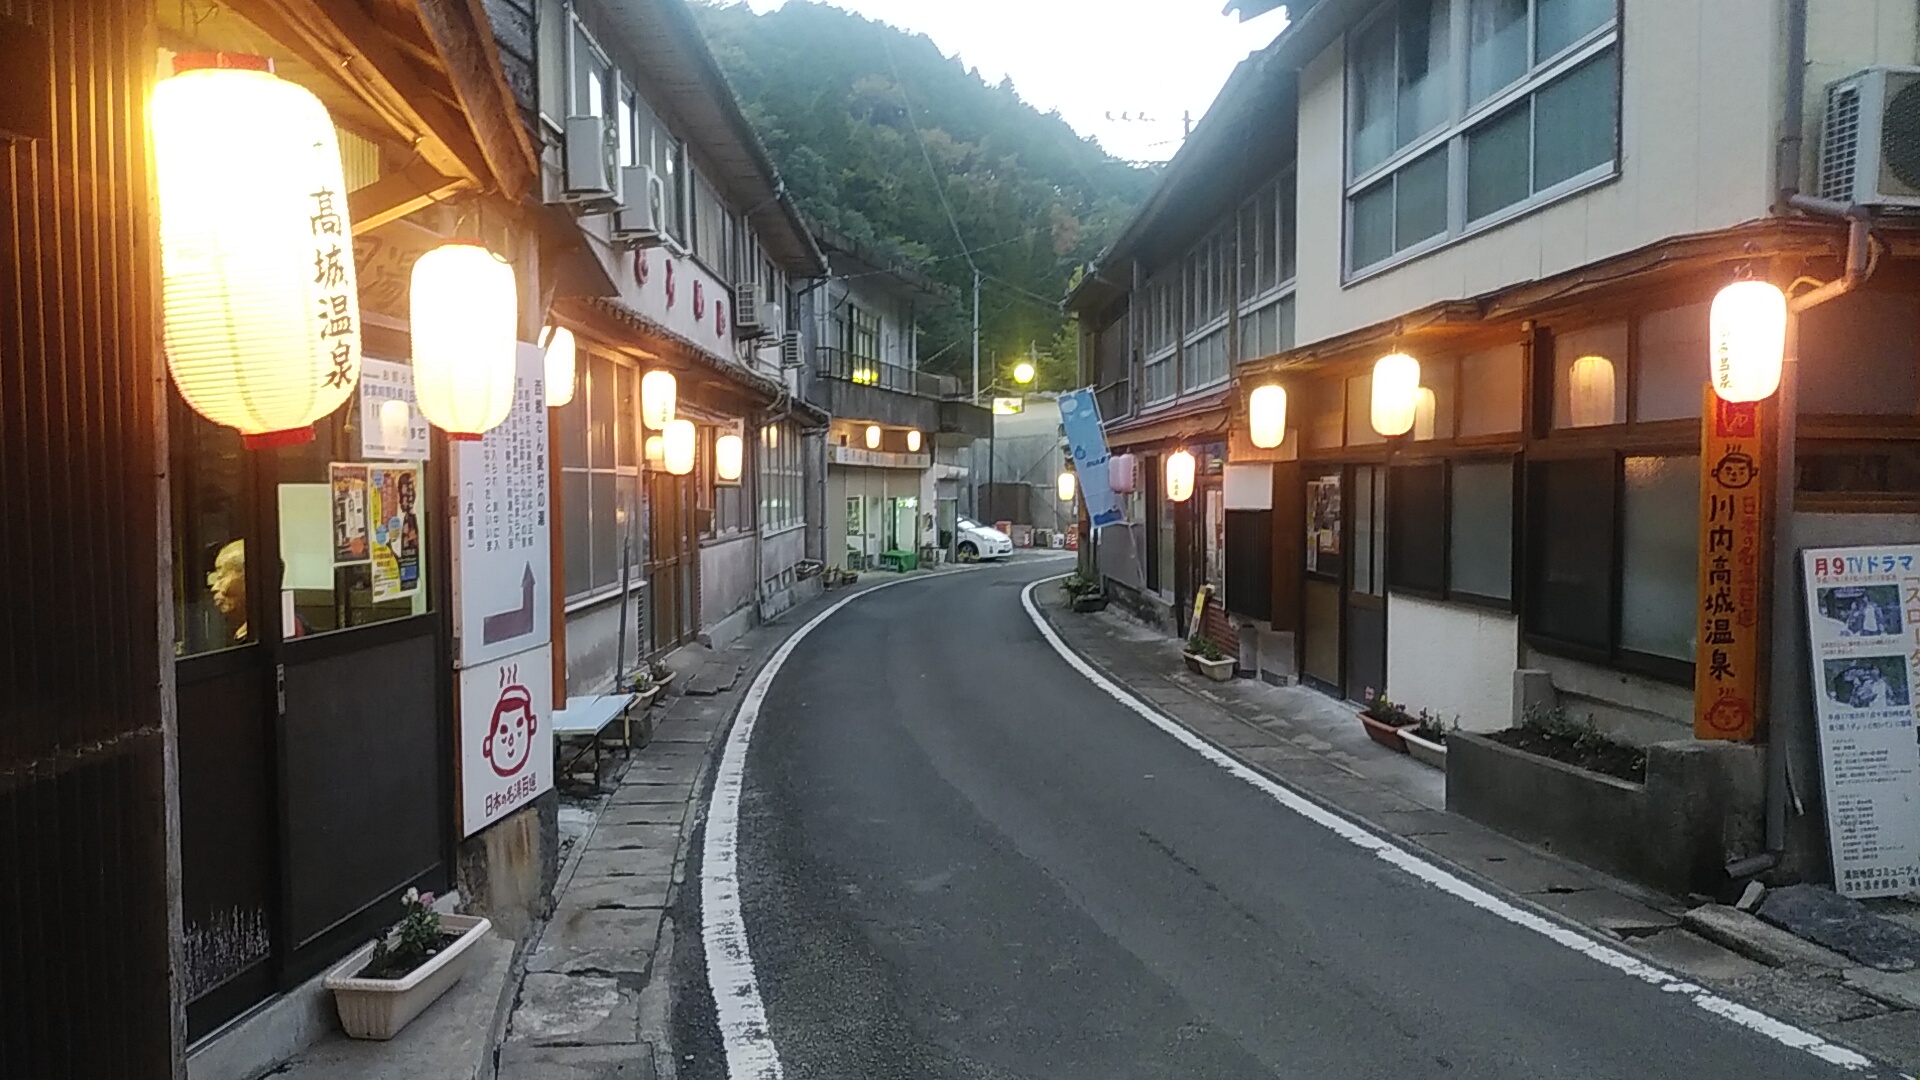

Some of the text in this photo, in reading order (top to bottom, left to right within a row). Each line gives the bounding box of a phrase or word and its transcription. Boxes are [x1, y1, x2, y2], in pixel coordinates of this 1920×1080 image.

[1705, 494, 1736, 682] 川内高城温泉
[1815, 555, 1913, 577] 月9TVドラマ
